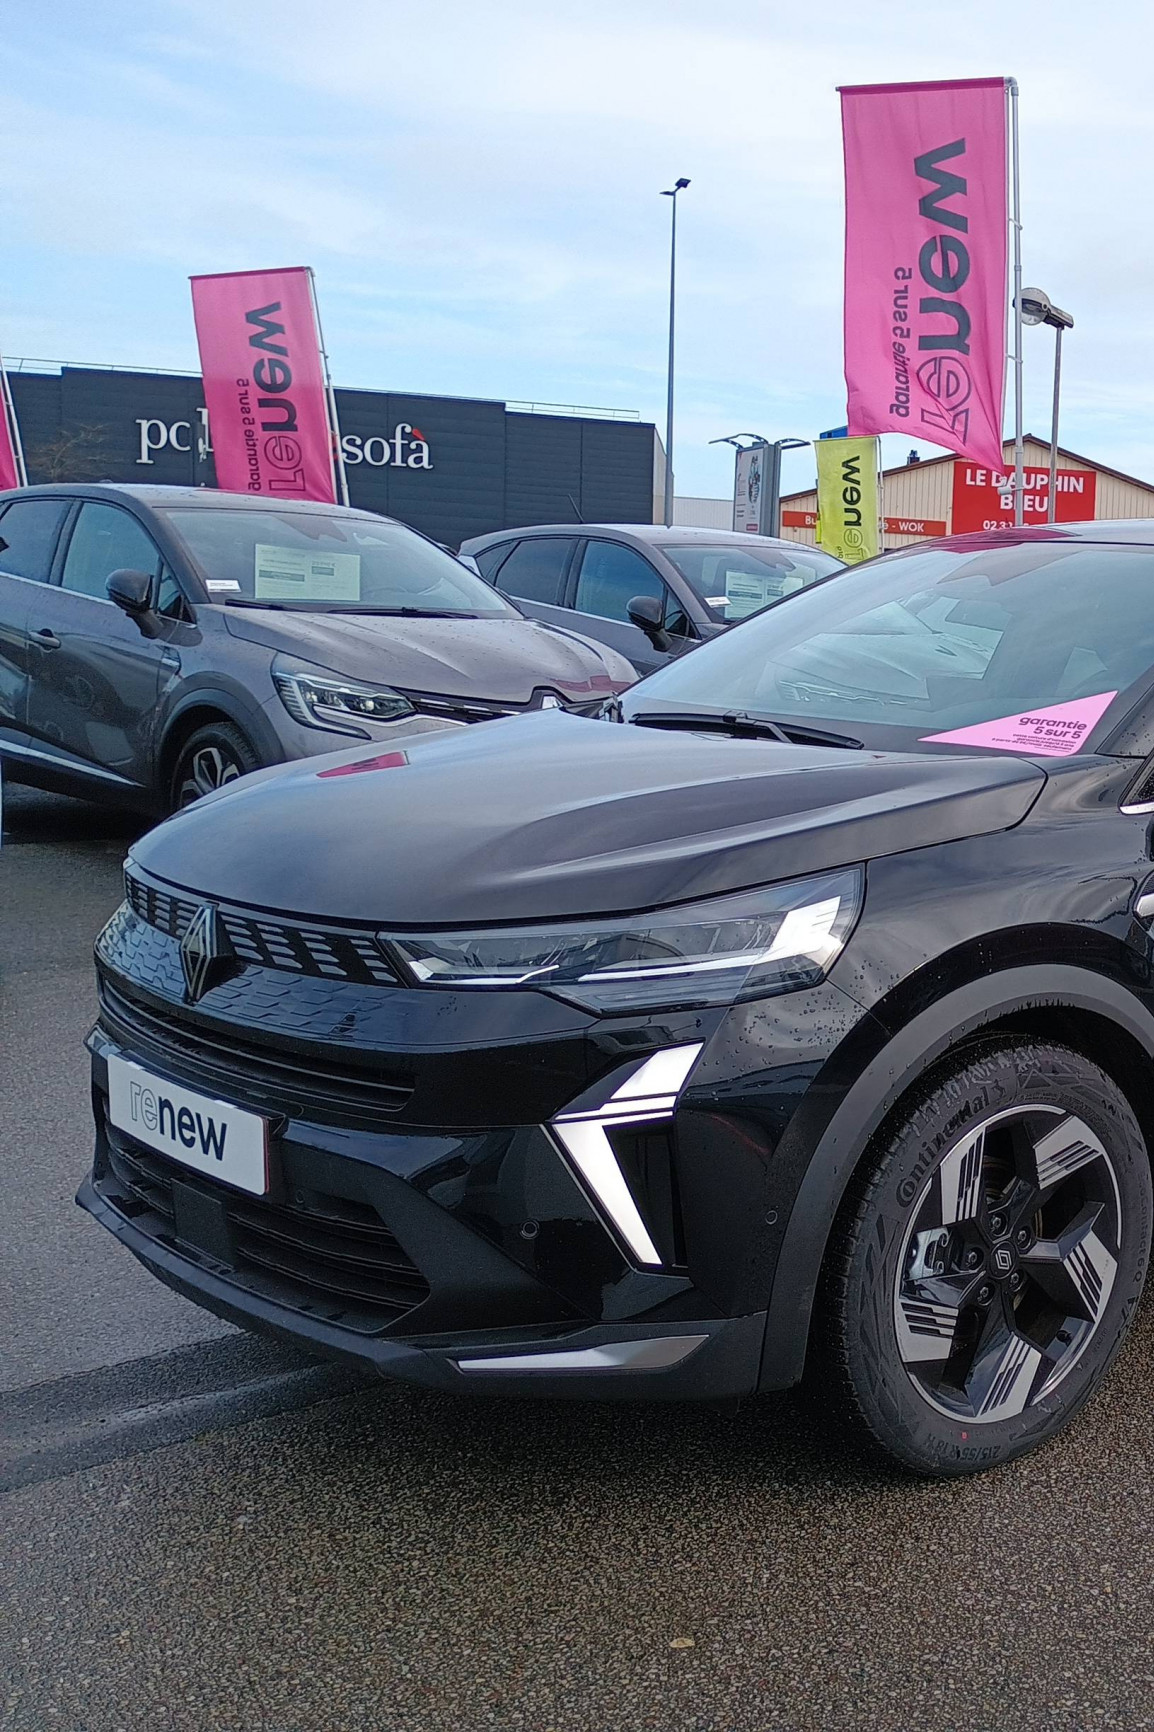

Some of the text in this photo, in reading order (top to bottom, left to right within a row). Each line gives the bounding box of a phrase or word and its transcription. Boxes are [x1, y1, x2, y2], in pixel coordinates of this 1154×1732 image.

[965, 468, 987, 486] LE
[898, 521, 925, 533] WOK
[1018, 717, 1087, 731] garantie
[1033, 726, 1083, 739] 5 sur 5
[129, 1081, 228, 1162] renew
[895, 1086, 990, 1208] Continental
[960, 1445, 1001, 1461] 215/55
